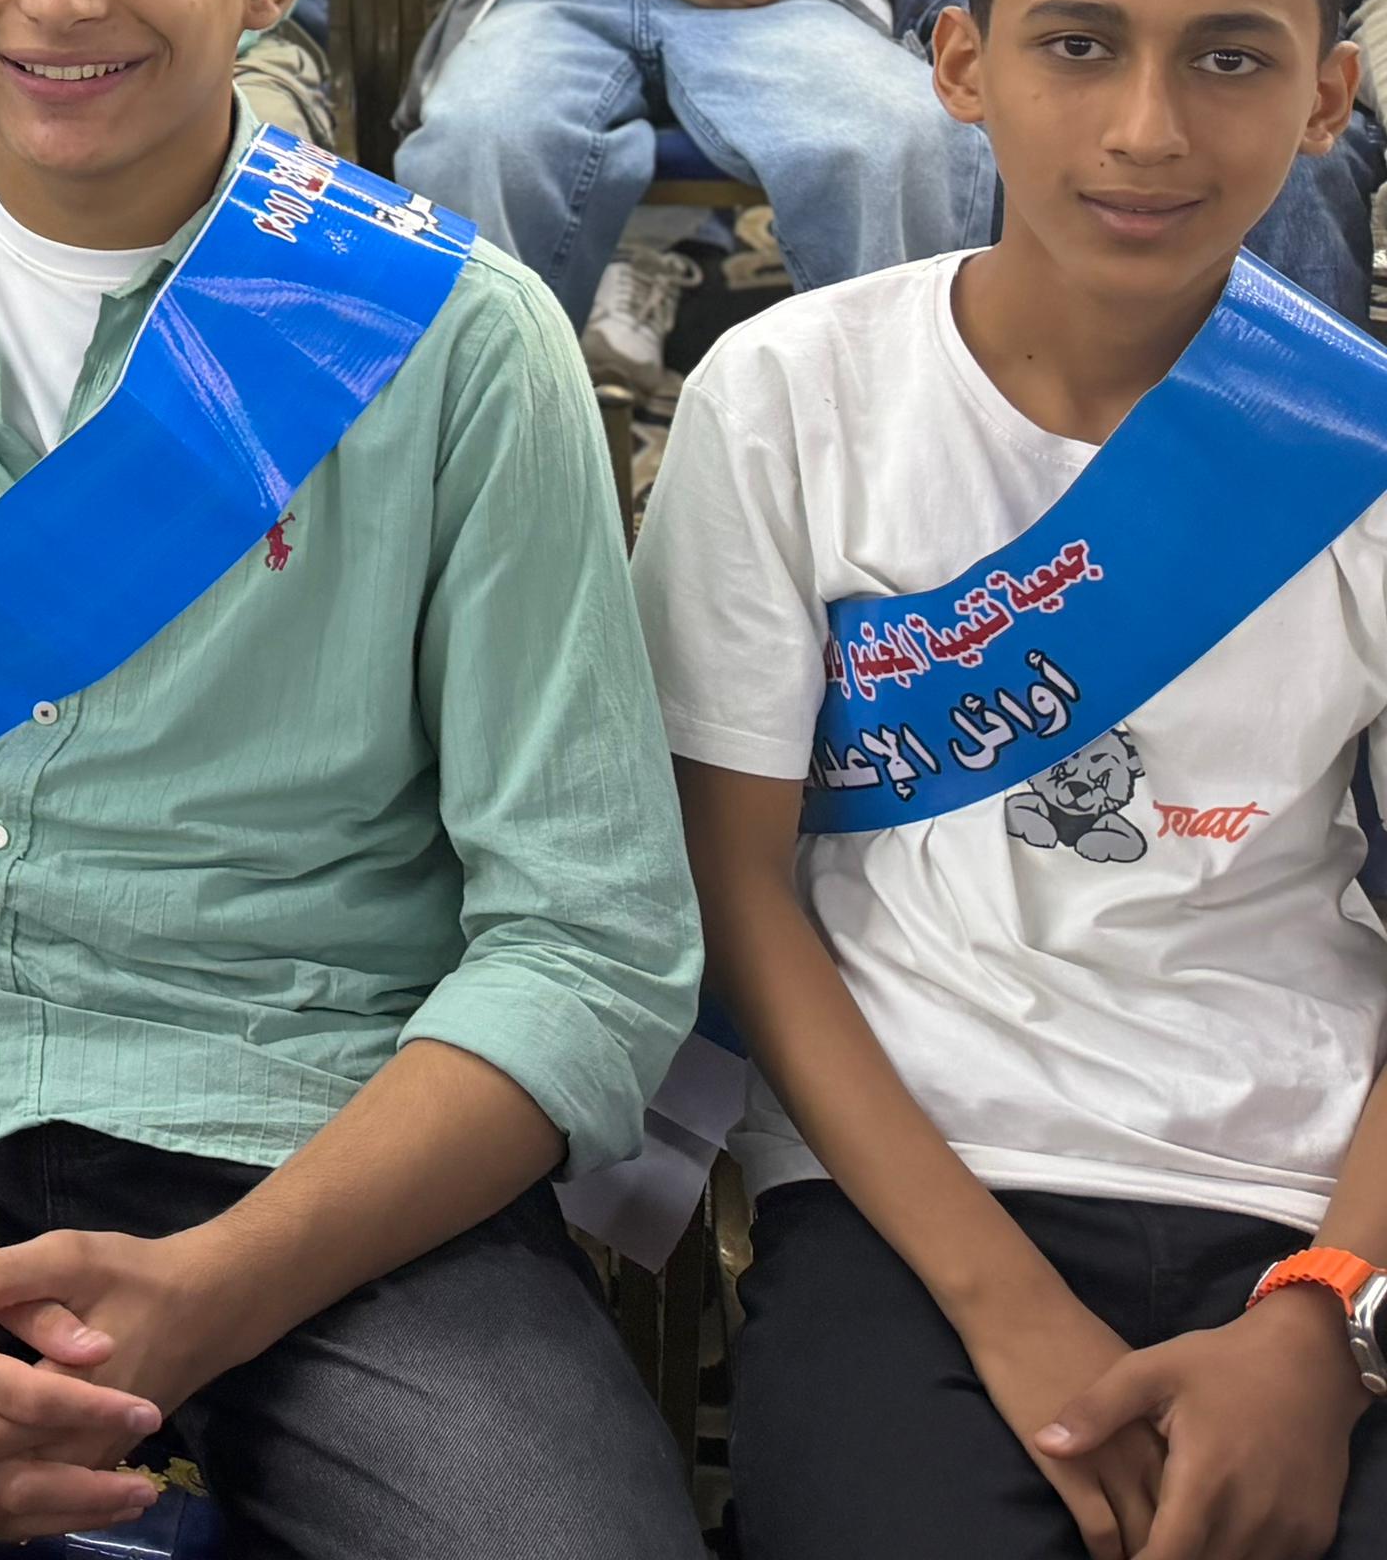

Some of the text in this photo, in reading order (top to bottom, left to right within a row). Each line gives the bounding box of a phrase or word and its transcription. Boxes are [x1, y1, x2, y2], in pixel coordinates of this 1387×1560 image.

[987, 540, 1103, 613] جمعية
[848, 620, 931, 701] المجتمع
[905, 588, 1014, 668] تنمية
[948, 649, 1081, 771] أوائل
[1153, 800, 1271, 843] Toast
